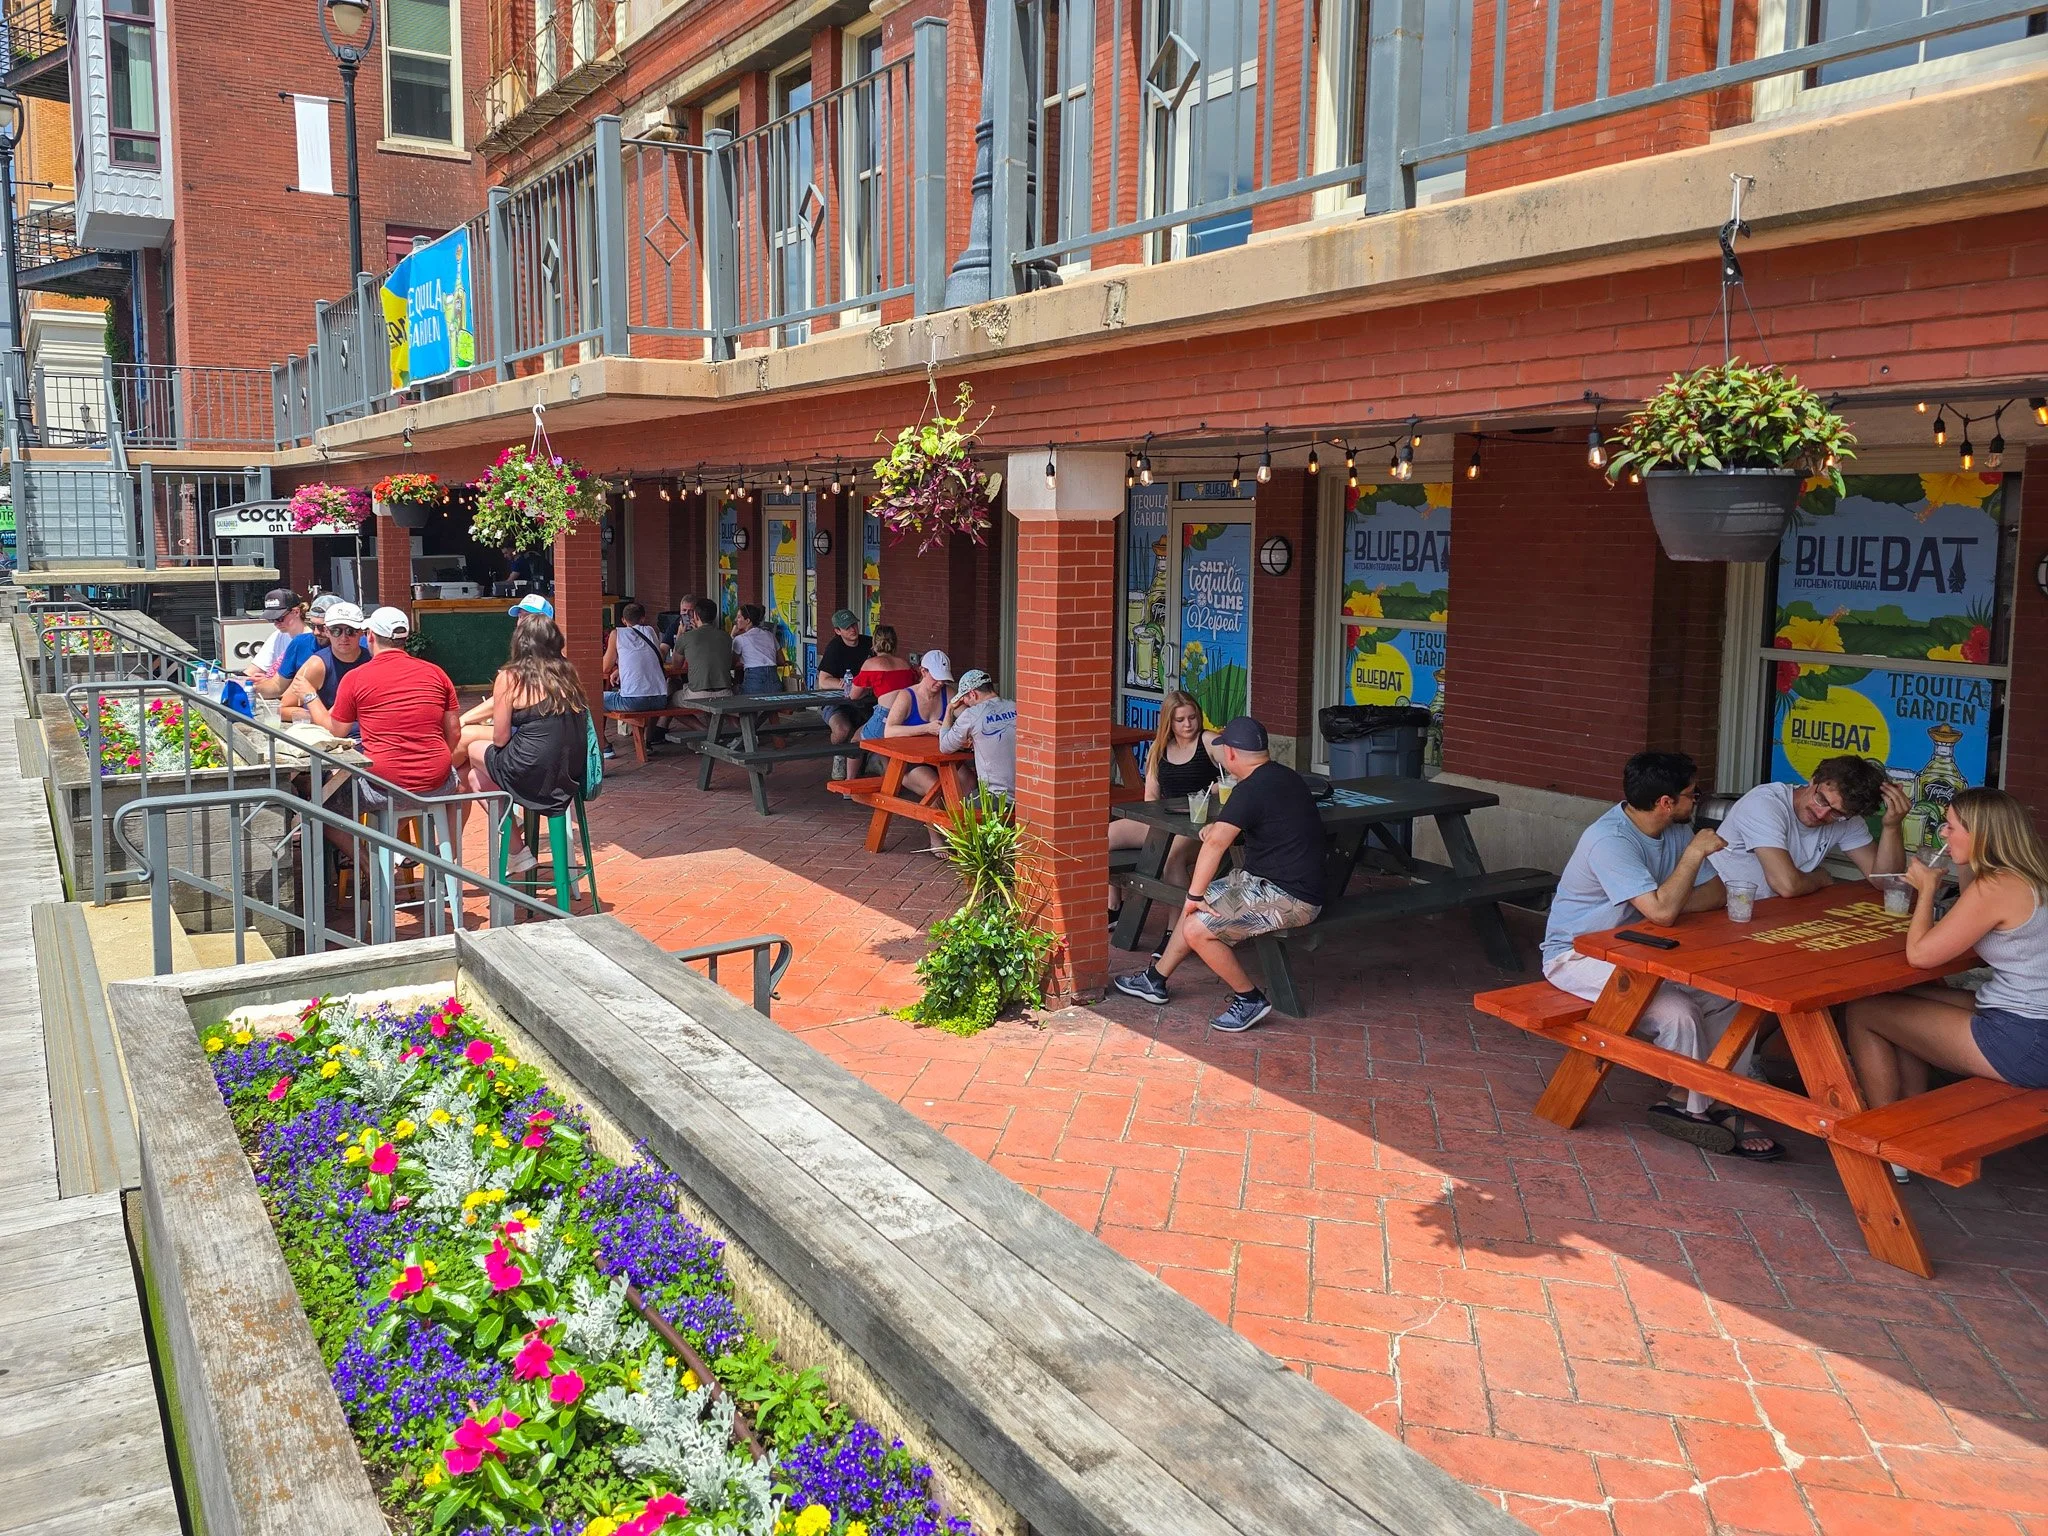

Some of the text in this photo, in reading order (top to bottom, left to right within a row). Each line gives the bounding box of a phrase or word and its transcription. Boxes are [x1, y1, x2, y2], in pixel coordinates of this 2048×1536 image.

[268, 524, 284, 532] on
[1187, 565, 1244, 604] tequila
[1213, 594, 1244, 611] LIME
[1187, 604, 1243, 640] Repeat
[1887, 672, 1988, 709] TEQUILA
[1896, 697, 1977, 726] GARDEN
